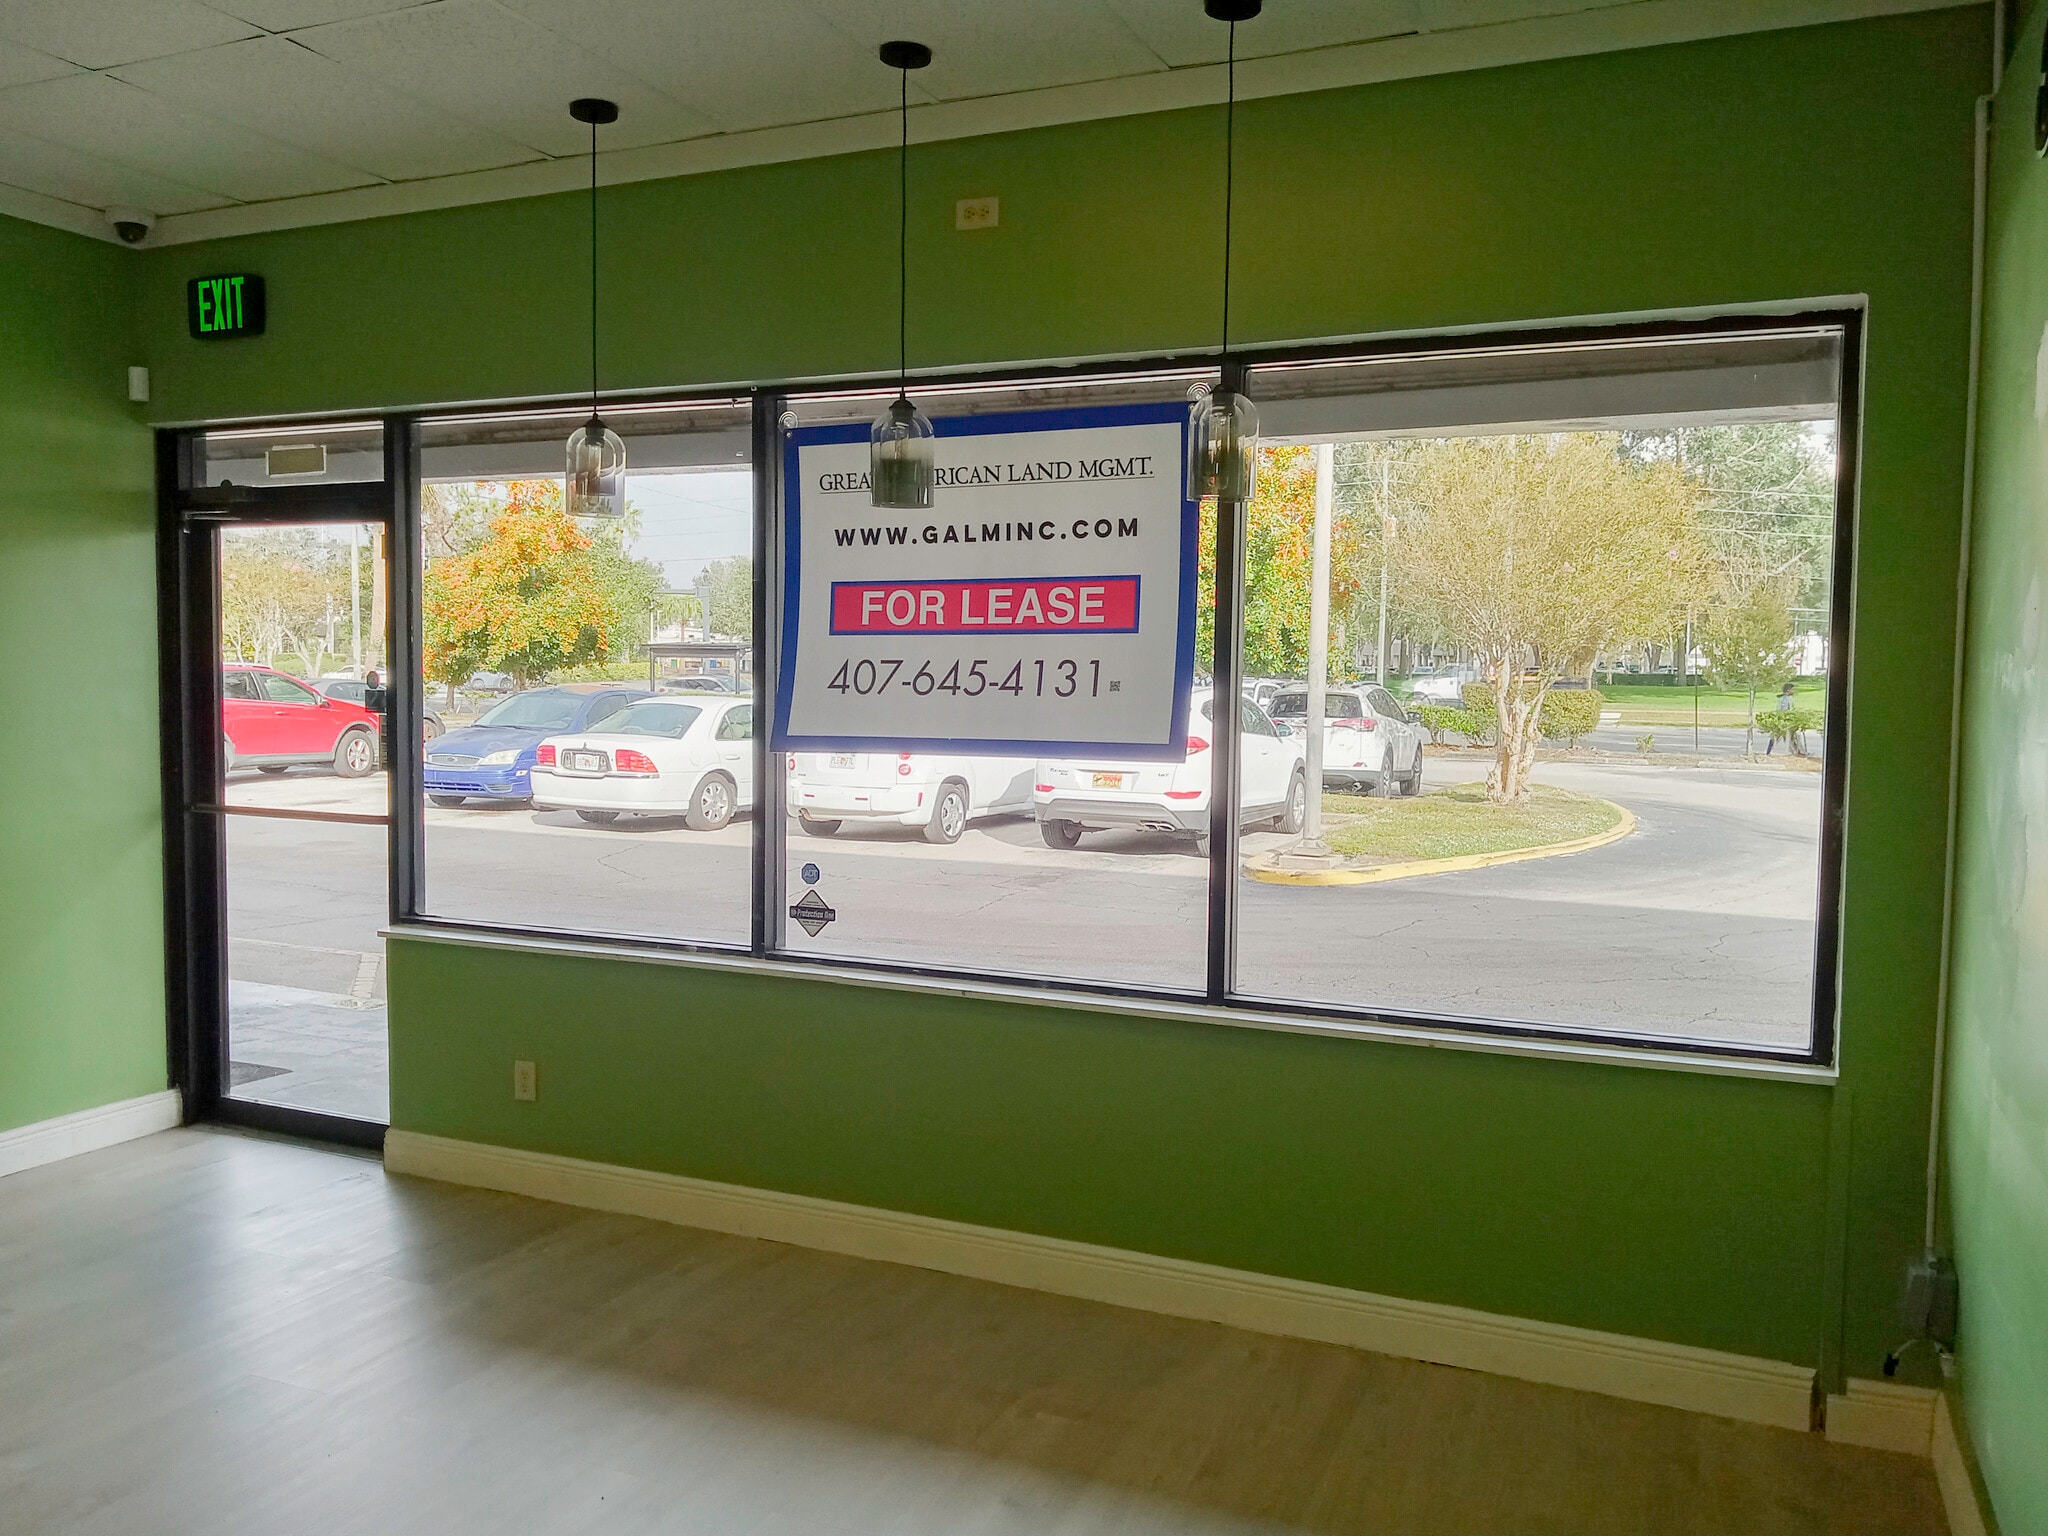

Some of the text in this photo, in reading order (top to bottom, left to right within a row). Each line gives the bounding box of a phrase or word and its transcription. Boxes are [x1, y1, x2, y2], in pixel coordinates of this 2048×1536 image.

[198, 276, 244, 332] EXIT
[819, 456, 1154, 491] GREA RICAN LAND MGMT.
[834, 517, 1138, 547] WWW.GALMINC.COM
[861, 586, 1105, 627] FOR LEASE
[827, 658, 1101, 698] 407-645-4131
